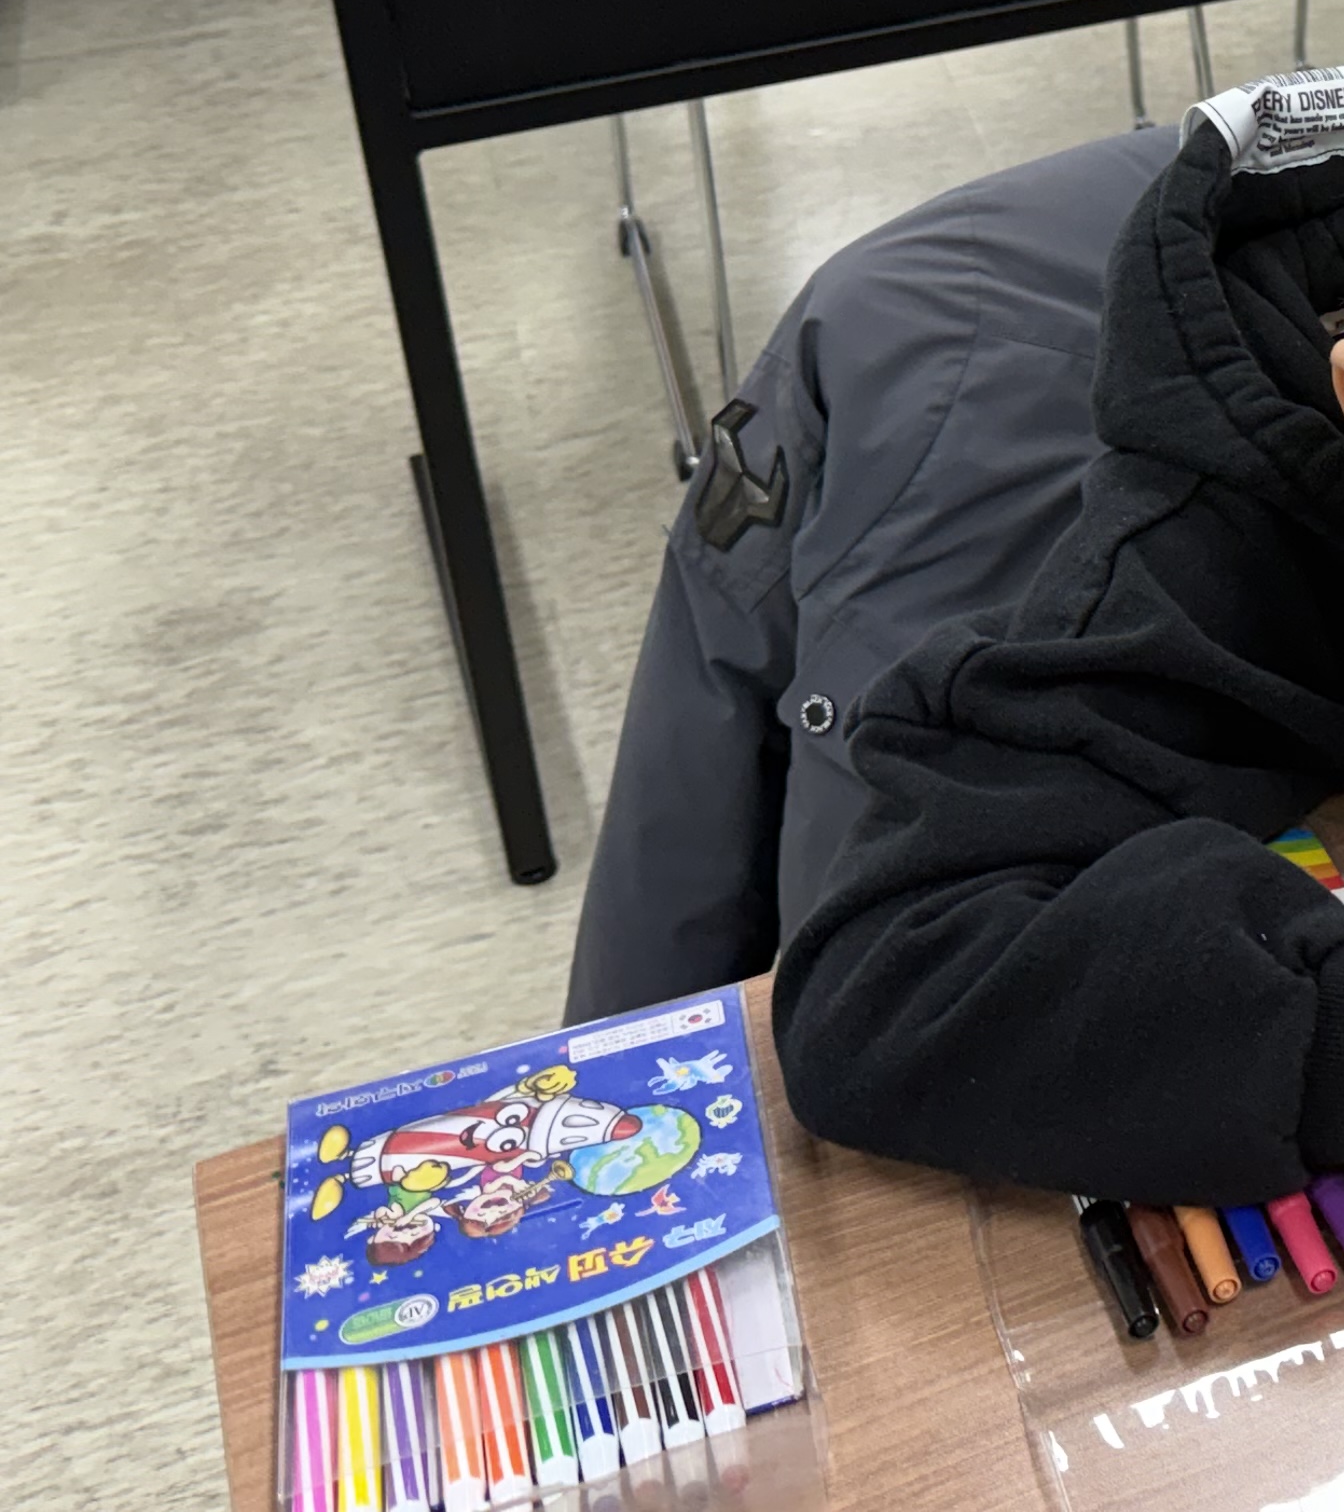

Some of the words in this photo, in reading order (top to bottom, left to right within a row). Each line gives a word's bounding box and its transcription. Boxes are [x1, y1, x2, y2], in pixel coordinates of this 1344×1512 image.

[663, 1214, 726, 1248] 지구
[568, 1237, 653, 1281] 슈퍼
[448, 1266, 560, 1312] 색연필
